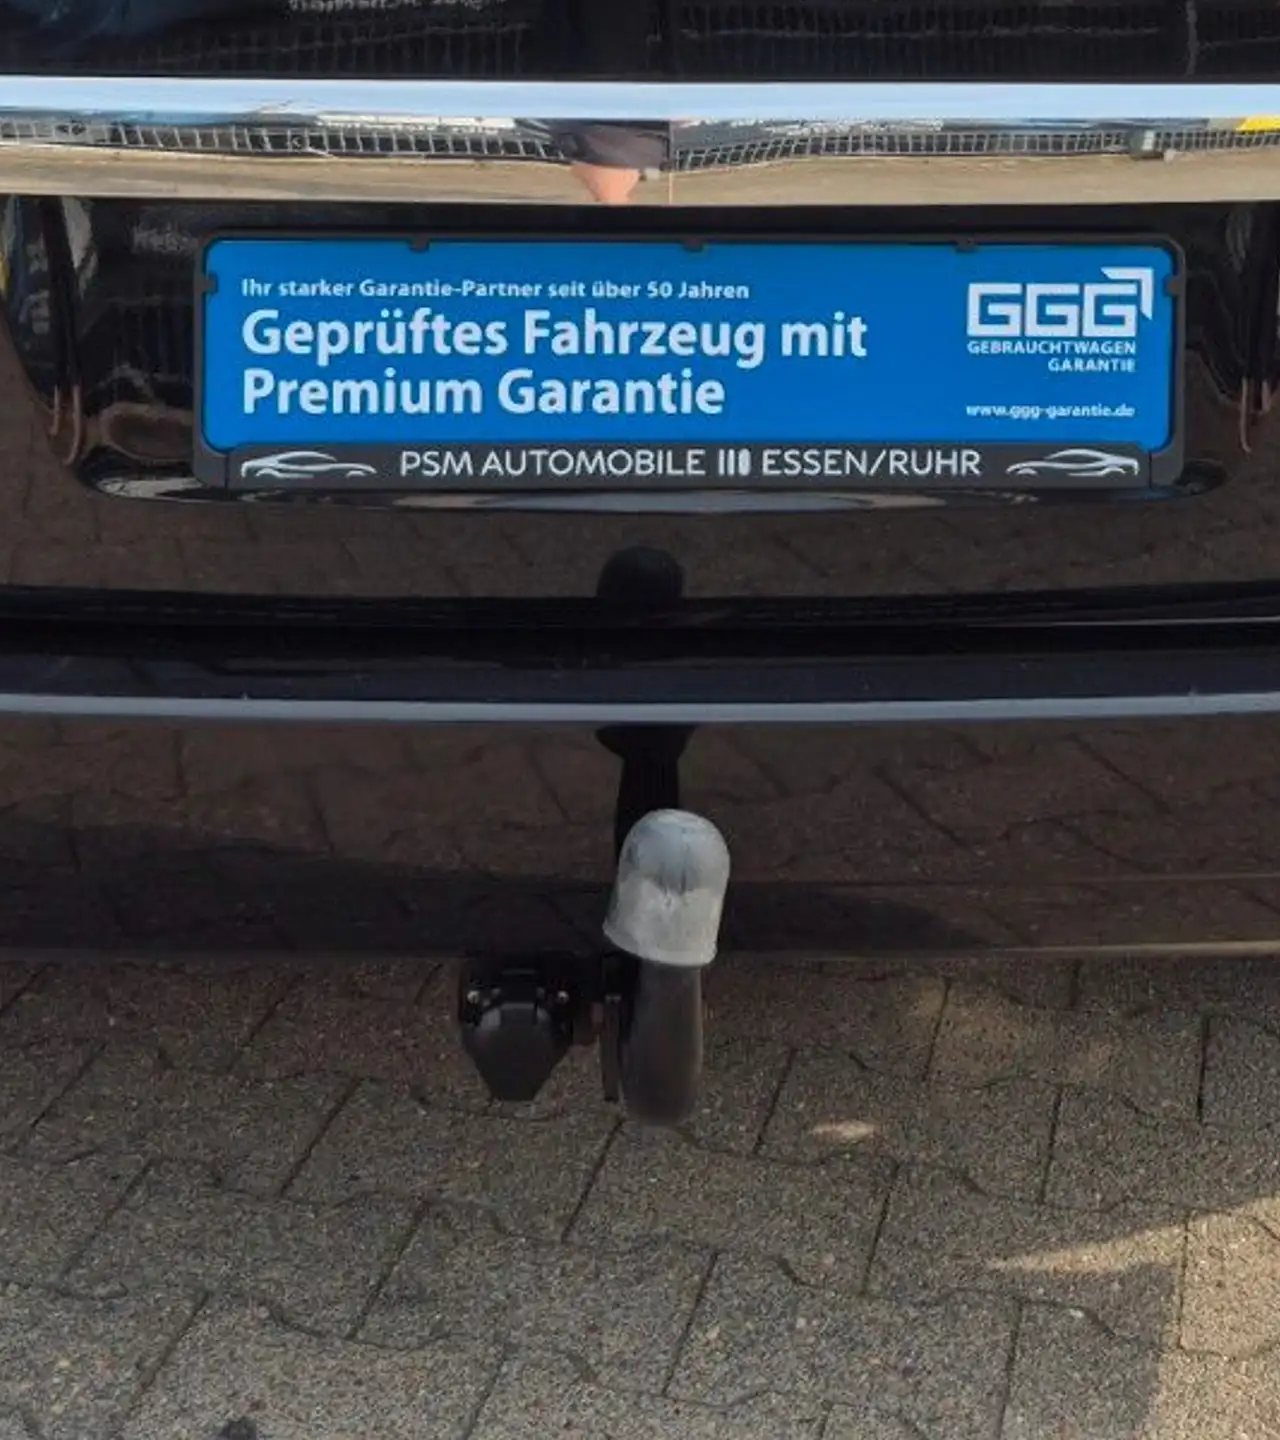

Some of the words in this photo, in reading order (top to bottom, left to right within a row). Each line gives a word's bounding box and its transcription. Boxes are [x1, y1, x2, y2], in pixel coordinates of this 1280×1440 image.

[241, 278, 272, 297] Ihr
[279, 278, 354, 297] starker
[359, 278, 542, 298] Garantie-Partner
[548, 281, 586, 299] seit
[591, 280, 642, 299] über
[646, 281, 673, 299] 50
[677, 281, 750, 301] Jahren
[967, 282, 1138, 337] GGG
[242, 308, 509, 367] Geprüftes
[524, 308, 766, 369] Fahrzeug
[781, 311, 868, 357] mit
[966, 340, 1137, 355] GEBRAUCHTWAGEN
[1047, 358, 1136, 373] GARANTIE
[243, 367, 483, 415] Premium
[497, 367, 726, 415] Garantie
[966, 403, 1135, 420] www.ggg-garantie.de
[400, 450, 473, 477] PSM
[481, 449, 705, 477] AUTOMOBILE
[762, 449, 982, 477] ESSEN/RUHR
